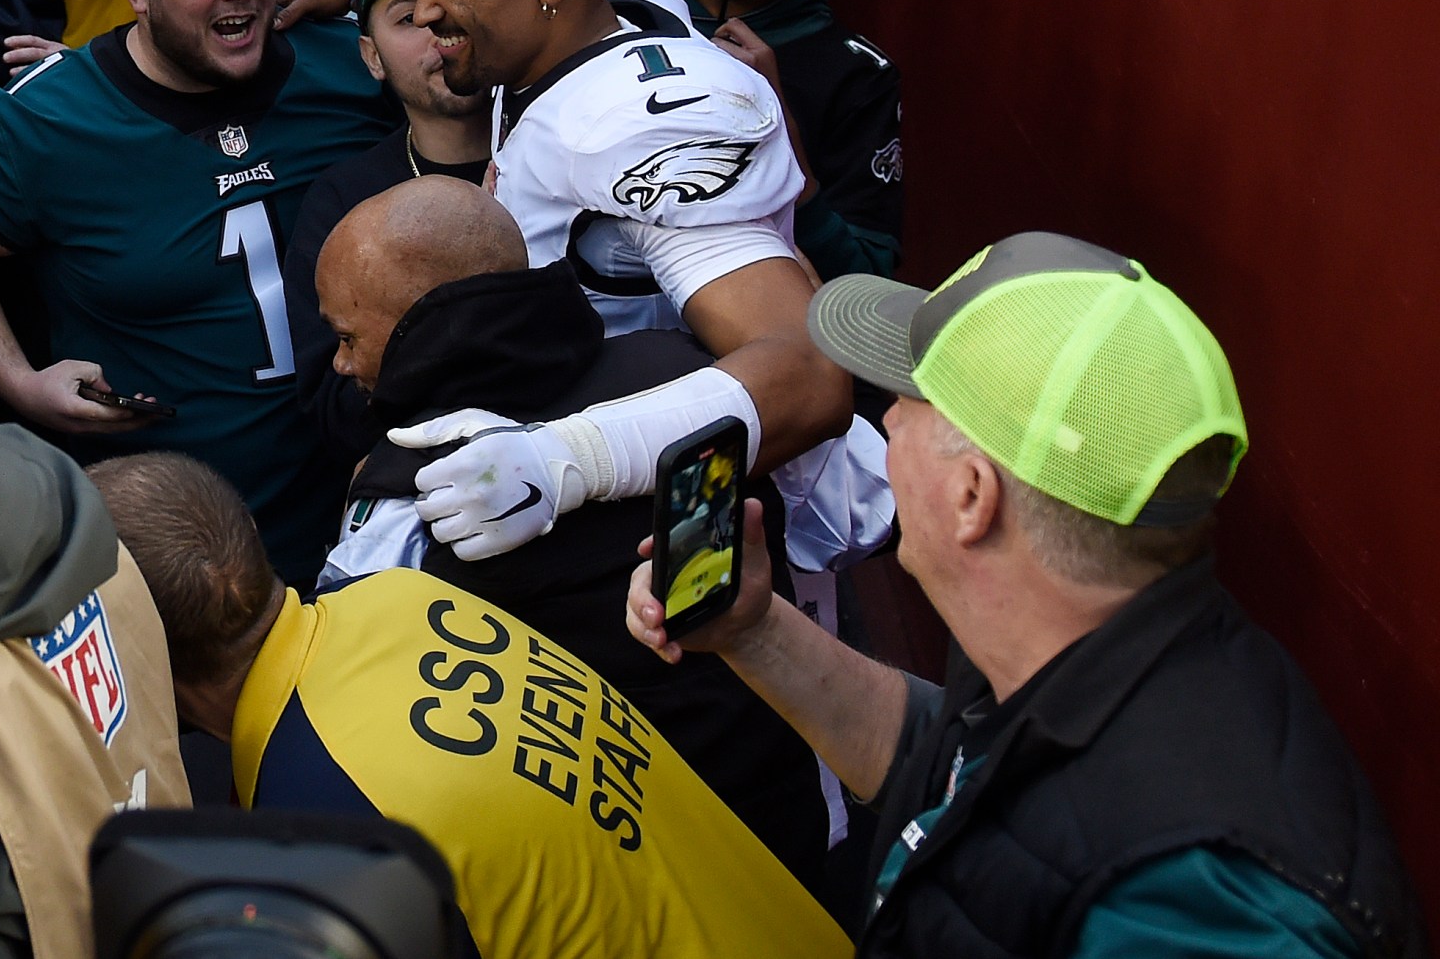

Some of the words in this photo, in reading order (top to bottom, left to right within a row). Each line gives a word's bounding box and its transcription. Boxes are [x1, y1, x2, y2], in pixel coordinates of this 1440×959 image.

[623, 43, 686, 83] 1
[214, 161, 275, 196] EAGLES
[220, 199, 296, 381] 1
[409, 599, 510, 756] CSC
[513, 635, 588, 807] EVENT
[589, 678, 651, 852] STAFF
